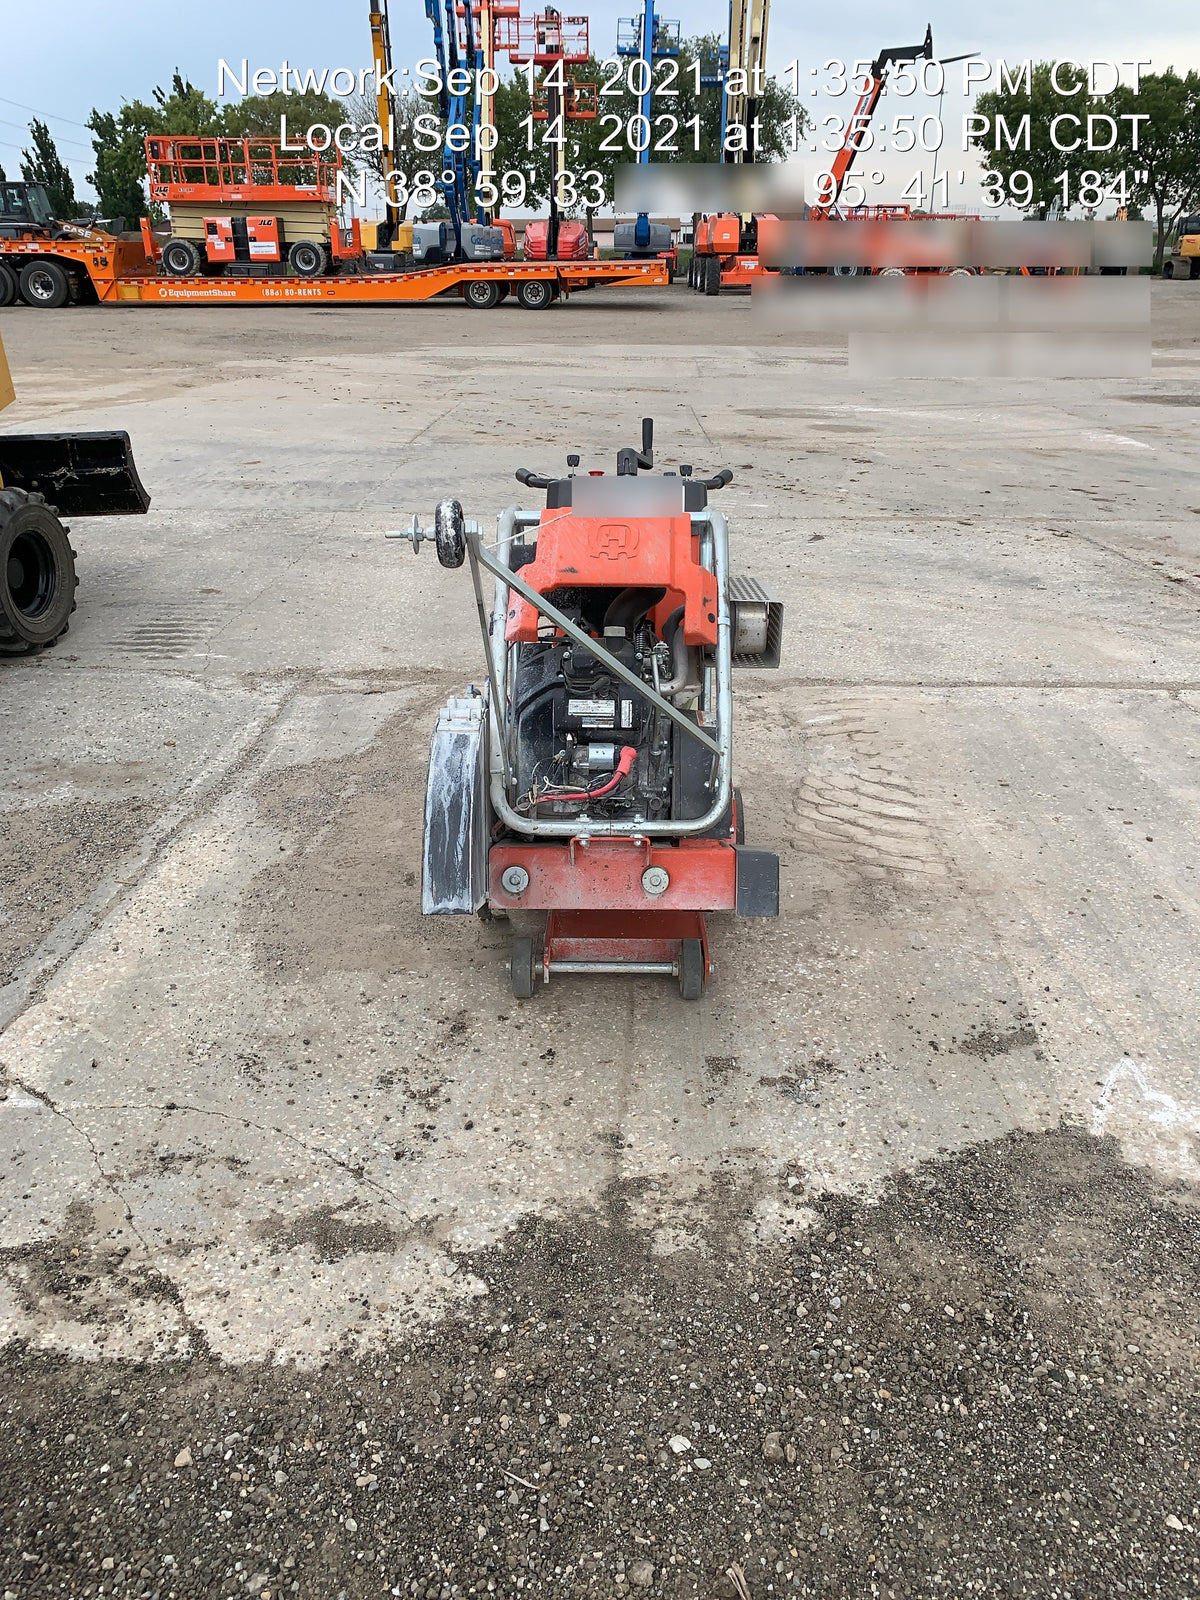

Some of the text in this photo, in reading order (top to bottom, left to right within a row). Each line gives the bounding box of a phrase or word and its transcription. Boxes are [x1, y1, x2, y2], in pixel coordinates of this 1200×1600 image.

[154, 185, 169, 193] JLG
[62, 225, 92, 238] CASE
[168, 289, 237, 297] EquipmentShare
[285, 288, 322, 296] 80-RENTS
